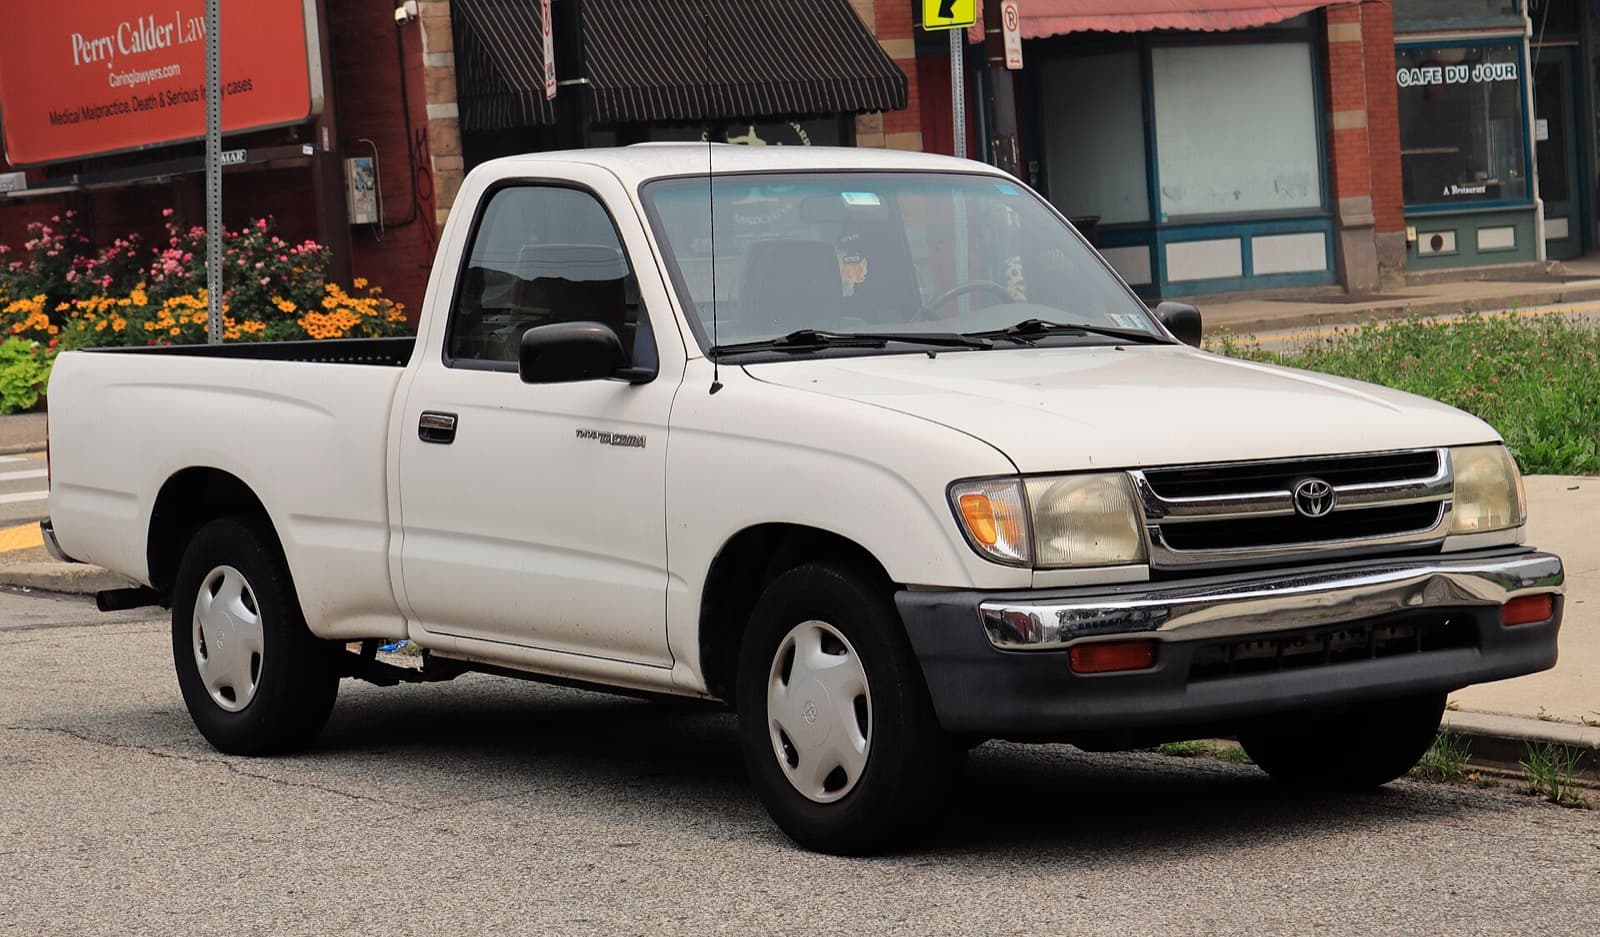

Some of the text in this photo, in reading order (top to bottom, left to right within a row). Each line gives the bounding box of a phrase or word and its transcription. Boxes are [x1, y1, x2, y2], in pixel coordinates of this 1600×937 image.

[71, 32, 115, 69] Perry
[117, 14, 173, 55] Calder
[109, 64, 181, 88] Caringlawyers.com
[1397, 63, 1517, 87] CAFE DU JOUR
[49, 108, 80, 126] Medical
[132, 94, 158, 111] Death
[159, 92, 166, 108] &
[167, 87, 199, 107] Serious
[227, 78, 253, 96] cases
